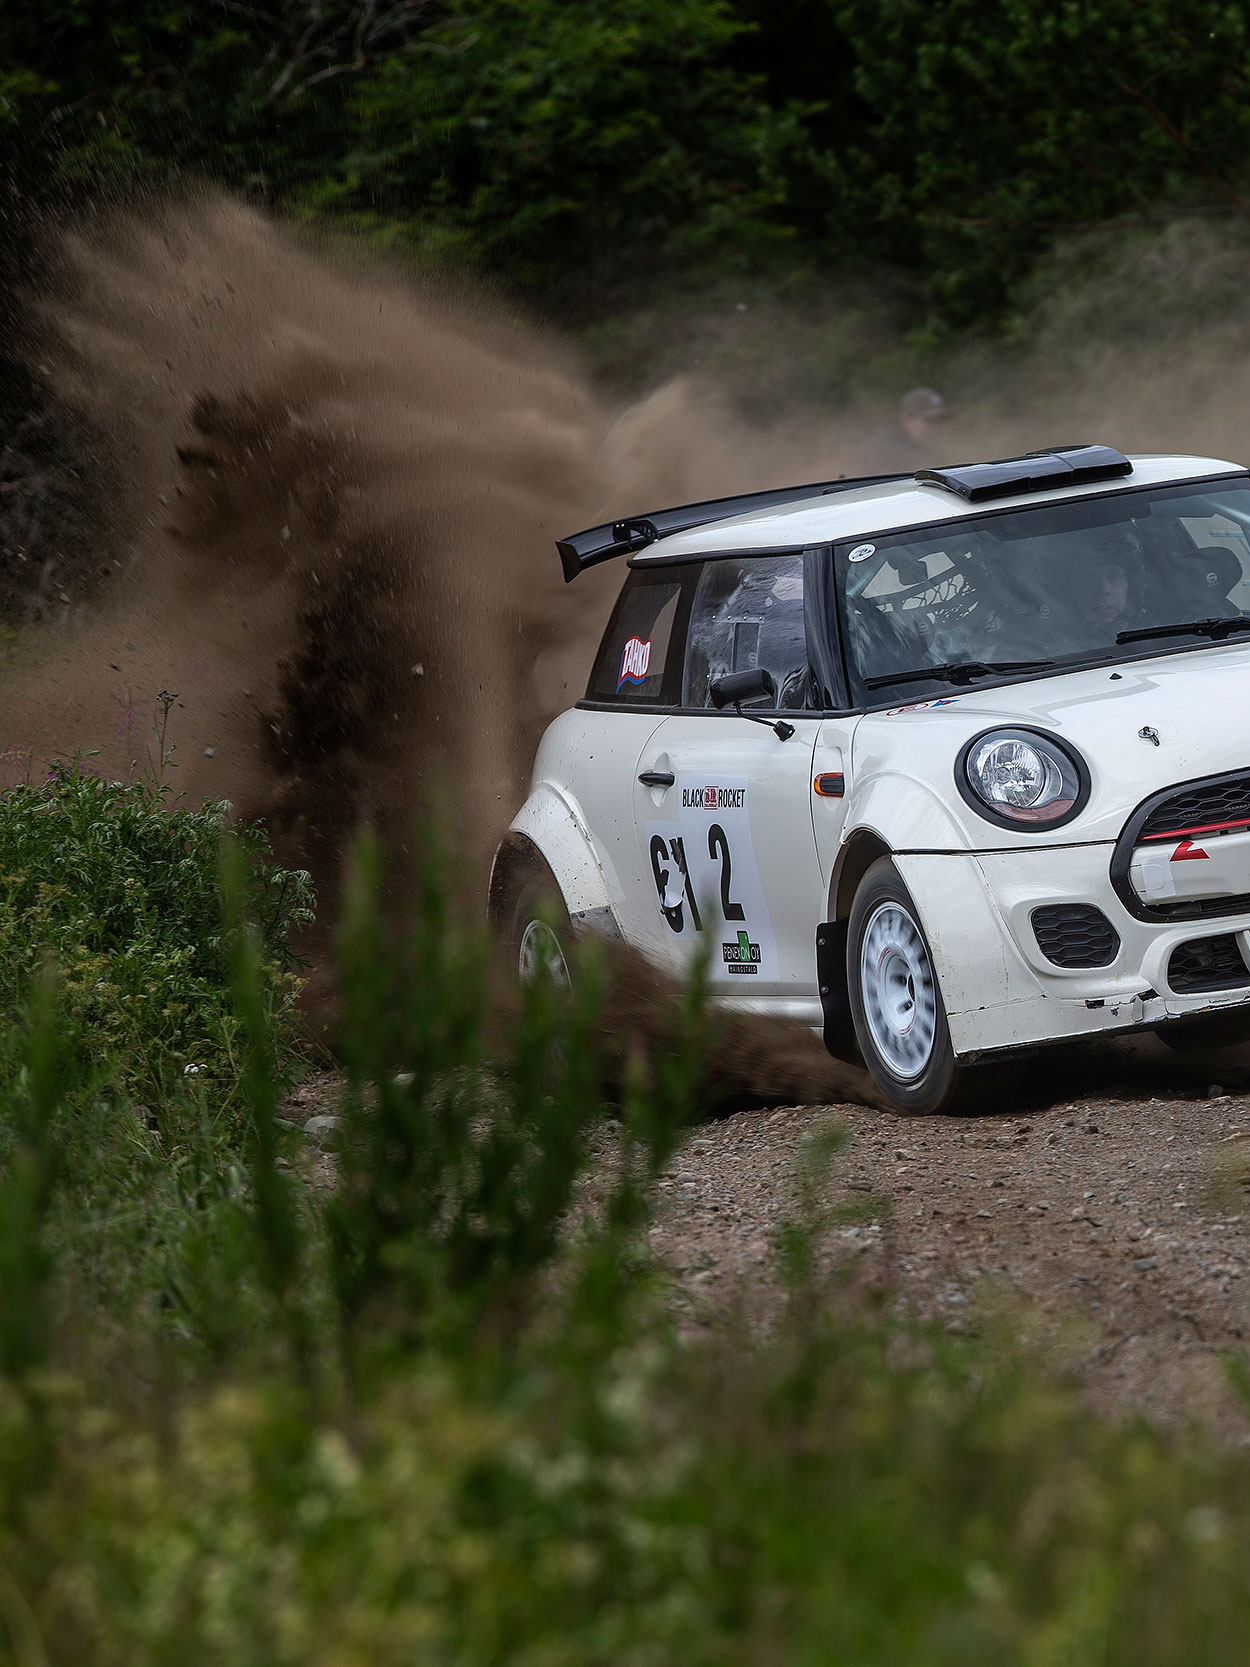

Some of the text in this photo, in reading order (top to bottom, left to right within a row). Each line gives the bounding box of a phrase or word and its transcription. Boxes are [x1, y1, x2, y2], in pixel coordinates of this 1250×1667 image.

[622, 639, 651, 677] TAHKO
[682, 788, 704, 808] BLACK
[718, 788, 746, 808] ROCKET
